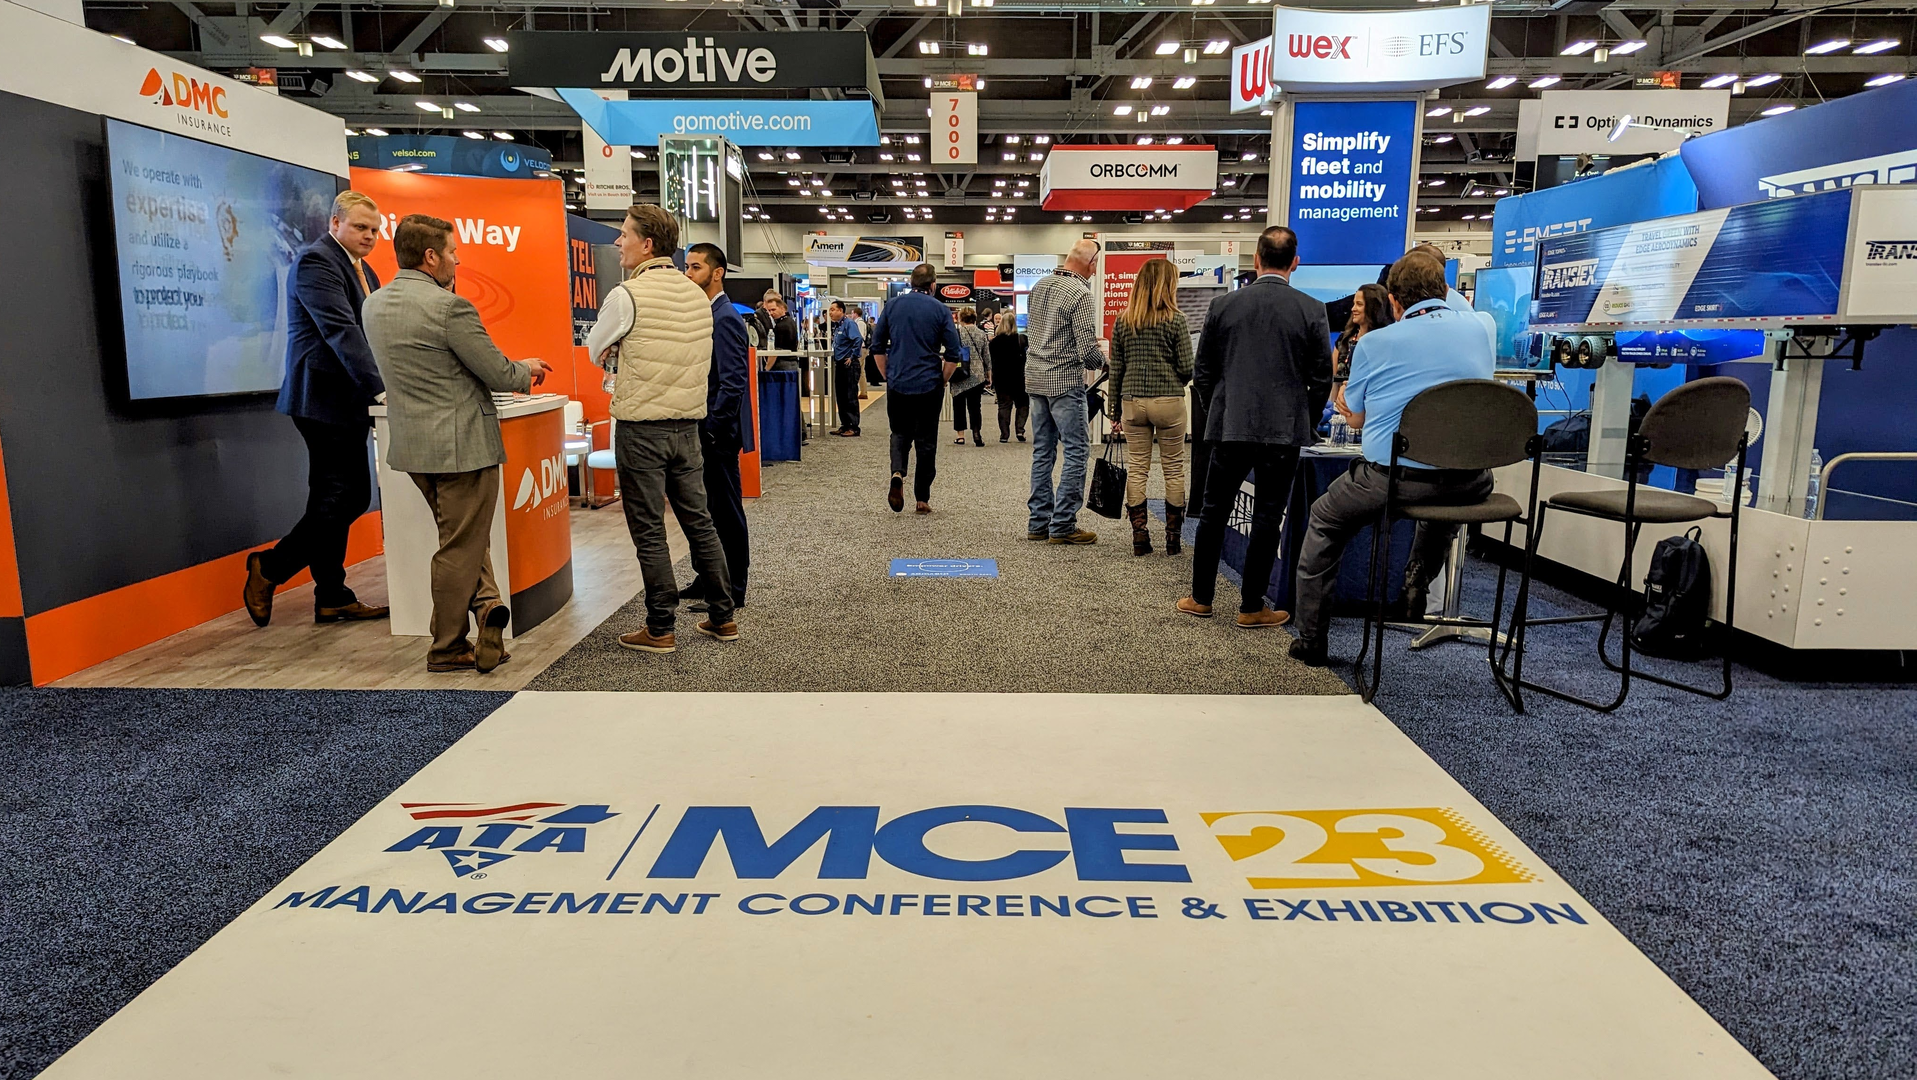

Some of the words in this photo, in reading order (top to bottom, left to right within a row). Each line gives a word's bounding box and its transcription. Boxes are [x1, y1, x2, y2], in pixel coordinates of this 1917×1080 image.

[1418, 32, 1466, 56] EFS
[600, 37, 776, 82] Motive
[172, 72, 228, 118] DMC
[177, 113, 232, 136] INSURANCE
[673, 110, 811, 134] gomotive.com
[948, 98, 960, 159] 7000
[1644, 116, 1713, 130] Dynamics
[392, 150, 436, 158] velsol.com
[1302, 131, 1391, 154] Simplify
[122, 159, 140, 177] We
[142, 167, 180, 186] operate
[182, 173, 203, 190] with
[1090, 164, 1178, 178] ORBCOMM
[1301, 156, 1350, 175] fleet
[1354, 160, 1382, 174] and
[1300, 180, 1386, 202] mobility
[126, 193, 206, 225] expertise
[1299, 204, 1399, 222] management
[128, 230, 148, 246] and
[150, 232, 180, 249] utilize
[455, 218, 521, 252] Way
[811, 239, 844, 250] Amerit
[1642, 230, 1662, 241] TRAVEL
[1684, 225, 1700, 236] WITH
[1636, 245, 1650, 254] EDGE
[132, 260, 174, 280] rigorous
[178, 264, 219, 283] playbook
[1542, 258, 1599, 290] TRANSTEX
[541, 450, 567, 499] DMC
[383, 824, 587, 852] ATA
[645, 804, 1193, 883] MCE
[1207, 812, 1485, 882] 23
[272, 886, 722, 914] MANAGEMENT
[737, 893, 1159, 919] CONFERENCE
[1181, 897, 1227, 920] &
[1243, 898, 1589, 925] EXHIBITION
